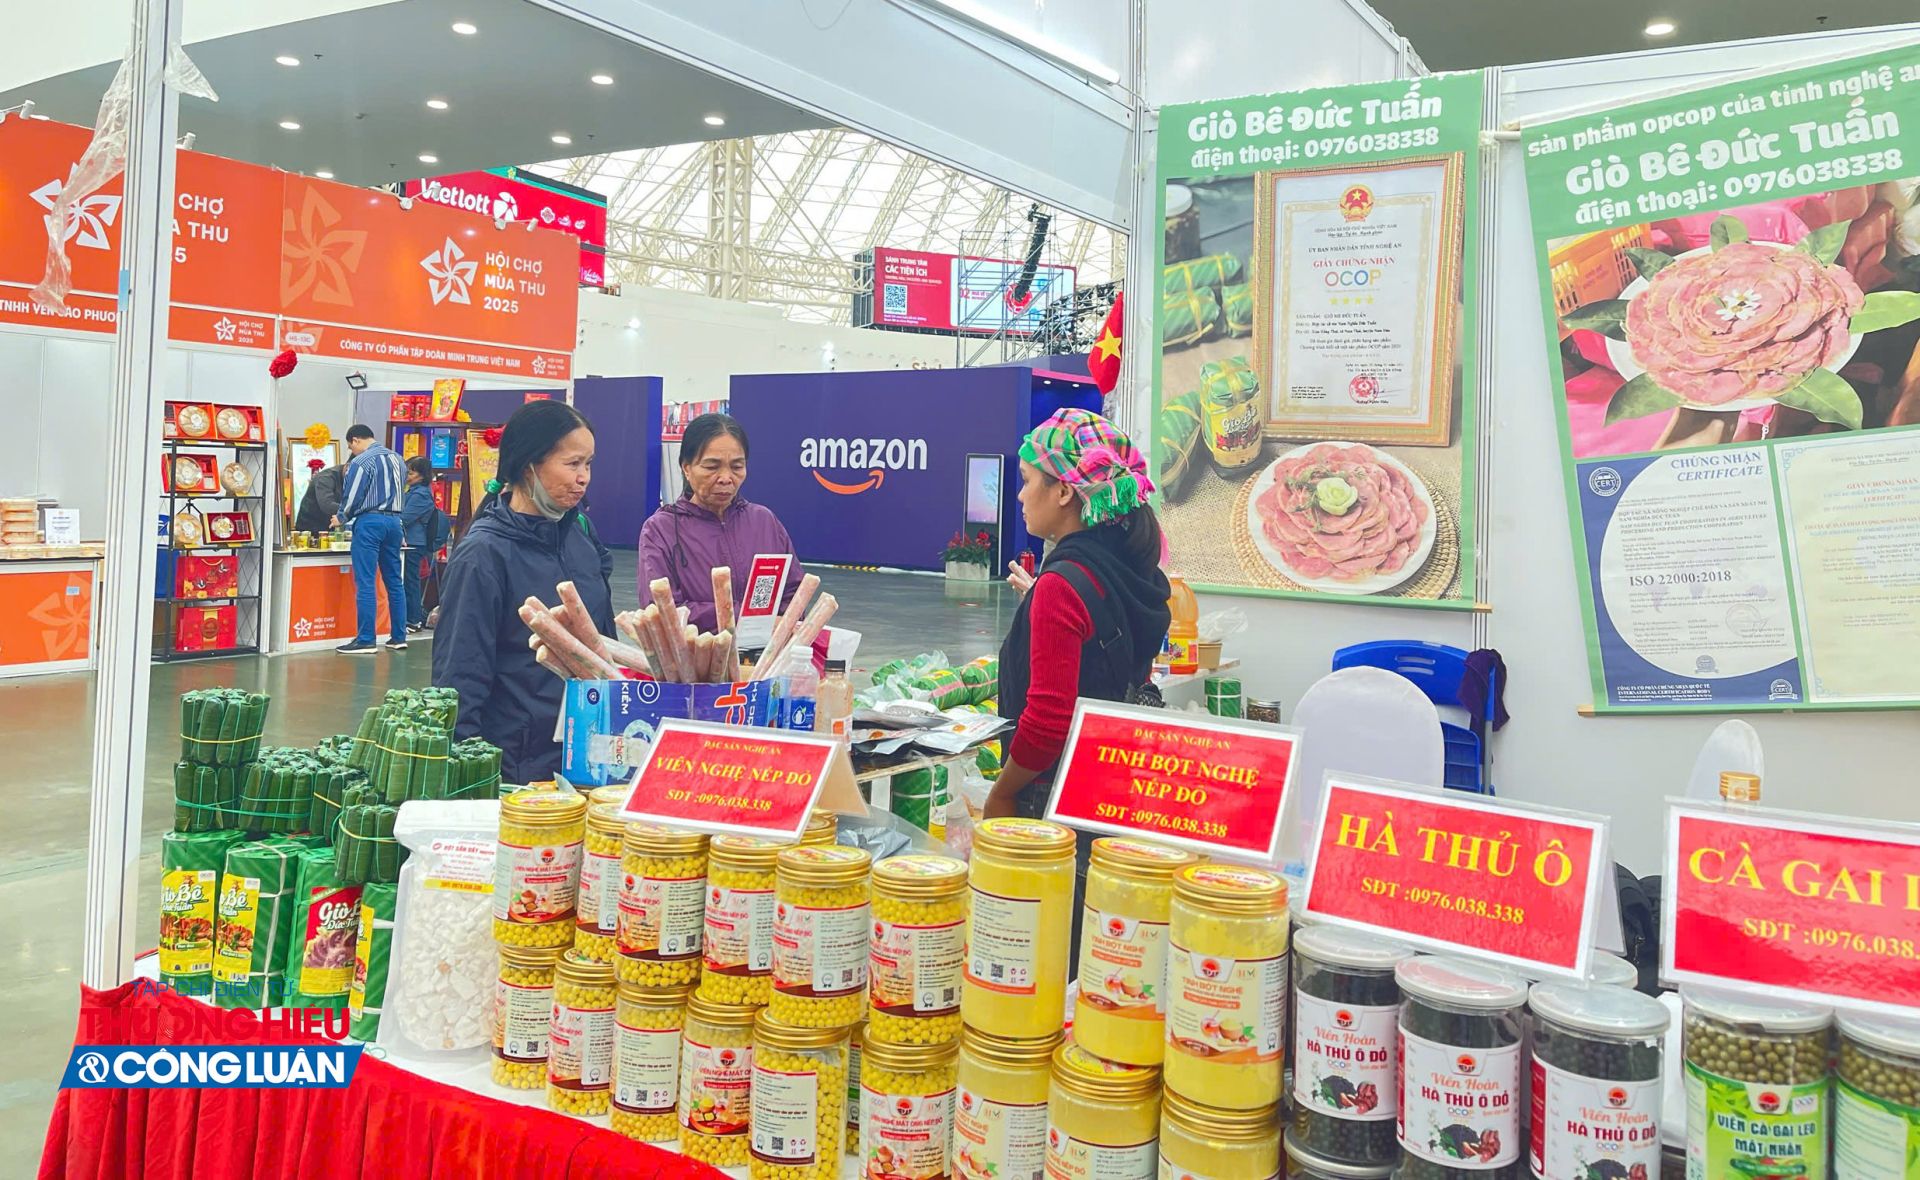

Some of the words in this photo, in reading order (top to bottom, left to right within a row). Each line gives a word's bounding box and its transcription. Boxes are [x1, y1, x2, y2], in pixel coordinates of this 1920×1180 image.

[1188, 111, 1237, 142] Giò
[1245, 106, 1284, 136] Bê
[1287, 99, 1353, 132] Đức
[1361, 80, 1442, 126] Tuấn
[1528, 134, 1567, 157] sản
[1573, 116, 1636, 152] phẩm
[1642, 105, 1716, 135] opcop
[1721, 93, 1766, 118] của
[1770, 83, 1823, 108] tỉnh
[1830, 66, 1893, 98] nghệ
[1191, 148, 1234, 170] điện
[1239, 140, 1300, 168] thoại:
[1304, 127, 1439, 159] 0976038338
[1565, 154, 1630, 195] Giò
[1639, 142, 1692, 182] Bê
[1695, 127, 1782, 171] Đức
[1789, 95, 1900, 154] Tuấn
[1575, 195, 1631, 225] điện
[1637, 180, 1718, 213] thoại:
[1723, 148, 1903, 199] 0976038338
[178, 193, 225, 220] CHỢ
[188, 221, 229, 243] THU
[485, 251, 510, 270] HỘI
[513, 258, 542, 278] CHỢ
[885, 265, 899, 274] CÁC
[484, 272, 515, 291] MÙA
[519, 280, 546, 294] THU
[1324, 269, 1381, 287] OCOP
[484, 296, 519, 314] 2025
[340, 338, 363, 351] CÔNG
[506, 358, 521, 368] NAM
[800, 437, 928, 470] amazon
[1671, 453, 1720, 469] CHỨNG
[1723, 451, 1762, 466] NHẬN
[1677, 465, 1763, 482] CERTIFICATE
[1629, 574, 1654, 587] ISO
[1658, 570, 1732, 584] 22000:2018
[1134, 727, 1155, 741] ĐẶC
[1216, 740, 1232, 750] AN
[656, 756, 694, 775] VIÊN
[698, 761, 746, 782] NGHỆ
[748, 765, 783, 783] NẾP
[1097, 746, 1146, 769] TINH
[1149, 753, 1194, 776] BỘT
[1197, 762, 1260, 790] NGHỆ
[1129, 777, 1172, 798] NẾP
[694, 793, 773, 812] :0976.038.338
[1095, 803, 1129, 821] SĐT
[1131, 810, 1228, 838] :0976.038.338
[1335, 811, 1400, 857] HÀ
[1417, 831, 1522, 877] THỦ
[1533, 838, 1573, 887] Ô
[1688, 841, 1766, 890] CÀ
[1781, 860, 1885, 907] GAI
[1361, 876, 1401, 898] SĐT
[1404, 886, 1524, 926] :0976.038.338
[319, 901, 351, 926] Giò
[1743, 917, 1796, 941] SĐT
[1307, 1039, 1321, 1054] HÀ
[1324, 1045, 1350, 1060] THỦ
[1355, 1048, 1365, 1062] Ô
[1369, 1046, 1387, 1062] ĐỎ
[1422, 1086, 1439, 1102] HÀ
[1444, 1091, 1473, 1107] THỦ
[1478, 1093, 1488, 1108] Ô
[1493, 1090, 1509, 1107] ĐỎ
[1567, 1120, 1588, 1137] HÀ
[1593, 1126, 1624, 1141] THỦ
[1628, 1127, 1638, 1142] Ô
[1717, 1113, 1745, 1133] VIÊN
[1751, 1121, 1768, 1136] CÀ
[1773, 1124, 1794, 1137] GAI
[1798, 1122, 1816, 1136] LEO
